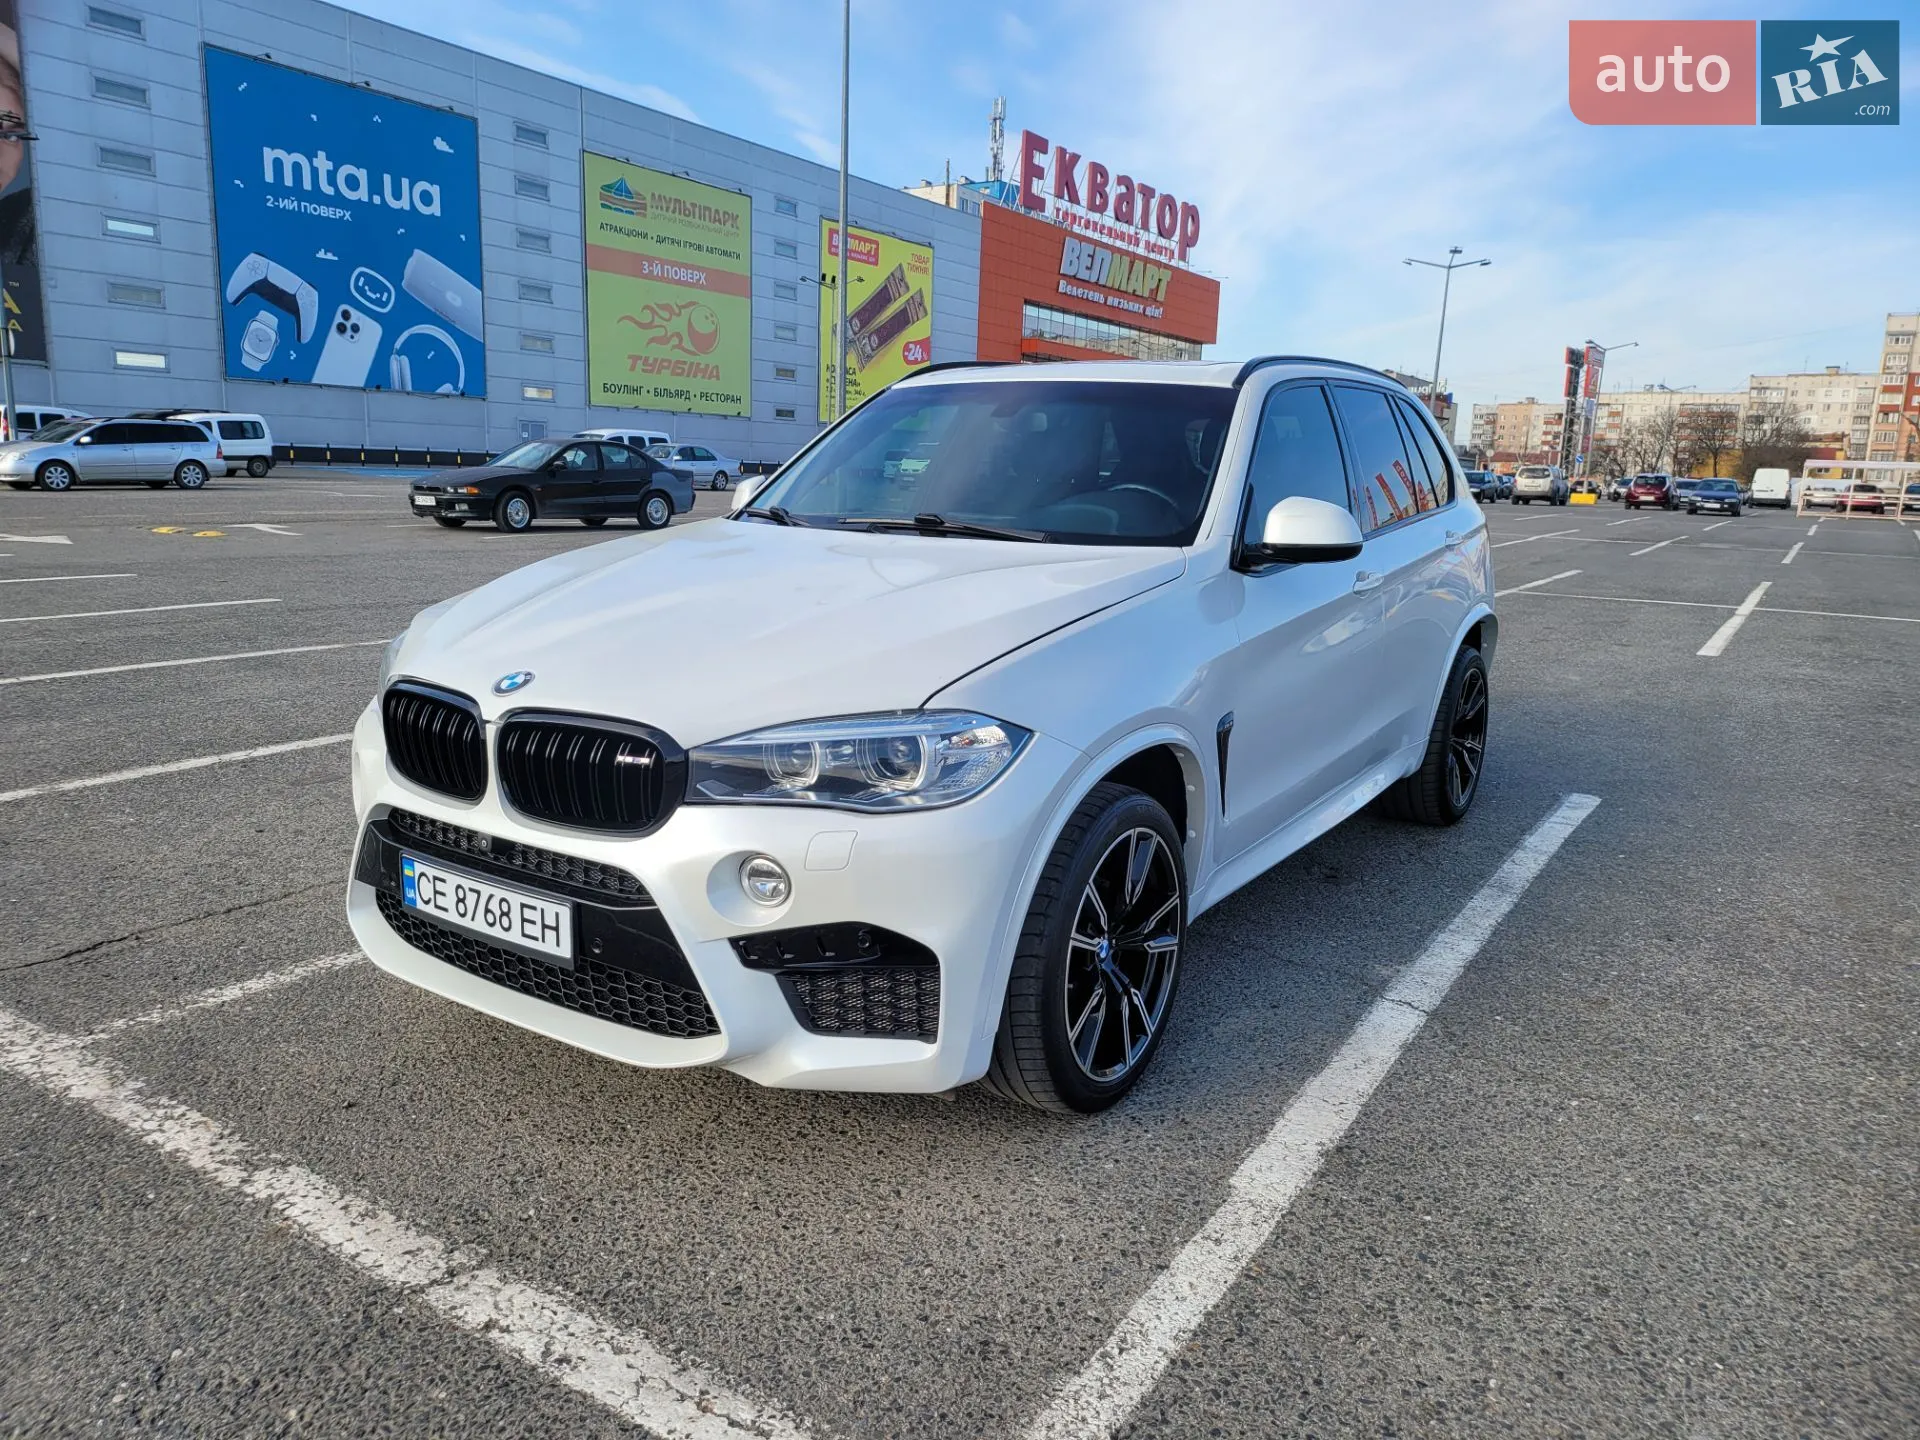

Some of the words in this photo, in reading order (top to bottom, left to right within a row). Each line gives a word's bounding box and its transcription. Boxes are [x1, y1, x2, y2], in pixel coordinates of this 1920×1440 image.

[262, 146, 441, 217] mta.ua
[266, 195, 298, 212] 2-ИЙ
[301, 203, 352, 221] ПОВЕРХ
[650, 192, 740, 230] МУЛЬТІПАРК
[600, 222, 649, 241] АТРАКЦІОНИ
[655, 234, 682, 249] ДИТЯЧІ
[683, 242, 705, 253] ІГРОВІ
[705, 246, 741, 261] АВТОМАТИ
[911, 252, 930, 266] ТОВАР
[642, 260, 661, 277] 3-Й
[664, 265, 706, 285] ПОВЕРХ
[1060, 236, 1172, 302] ВЕЛМАРТ
[1058, 279, 1105, 304] Велетень
[1106, 296, 1145, 314] низьких
[627, 354, 721, 381] ТУРБІНА
[602, 382, 644, 397] БОУЛІНГ
[653, 387, 692, 402] БІЛЬЯРД
[699, 391, 742, 405] РЕСТОРАН
[417, 871, 449, 913] CE
[455, 883, 512, 933] 8768
[520, 901, 561, 948] EH
